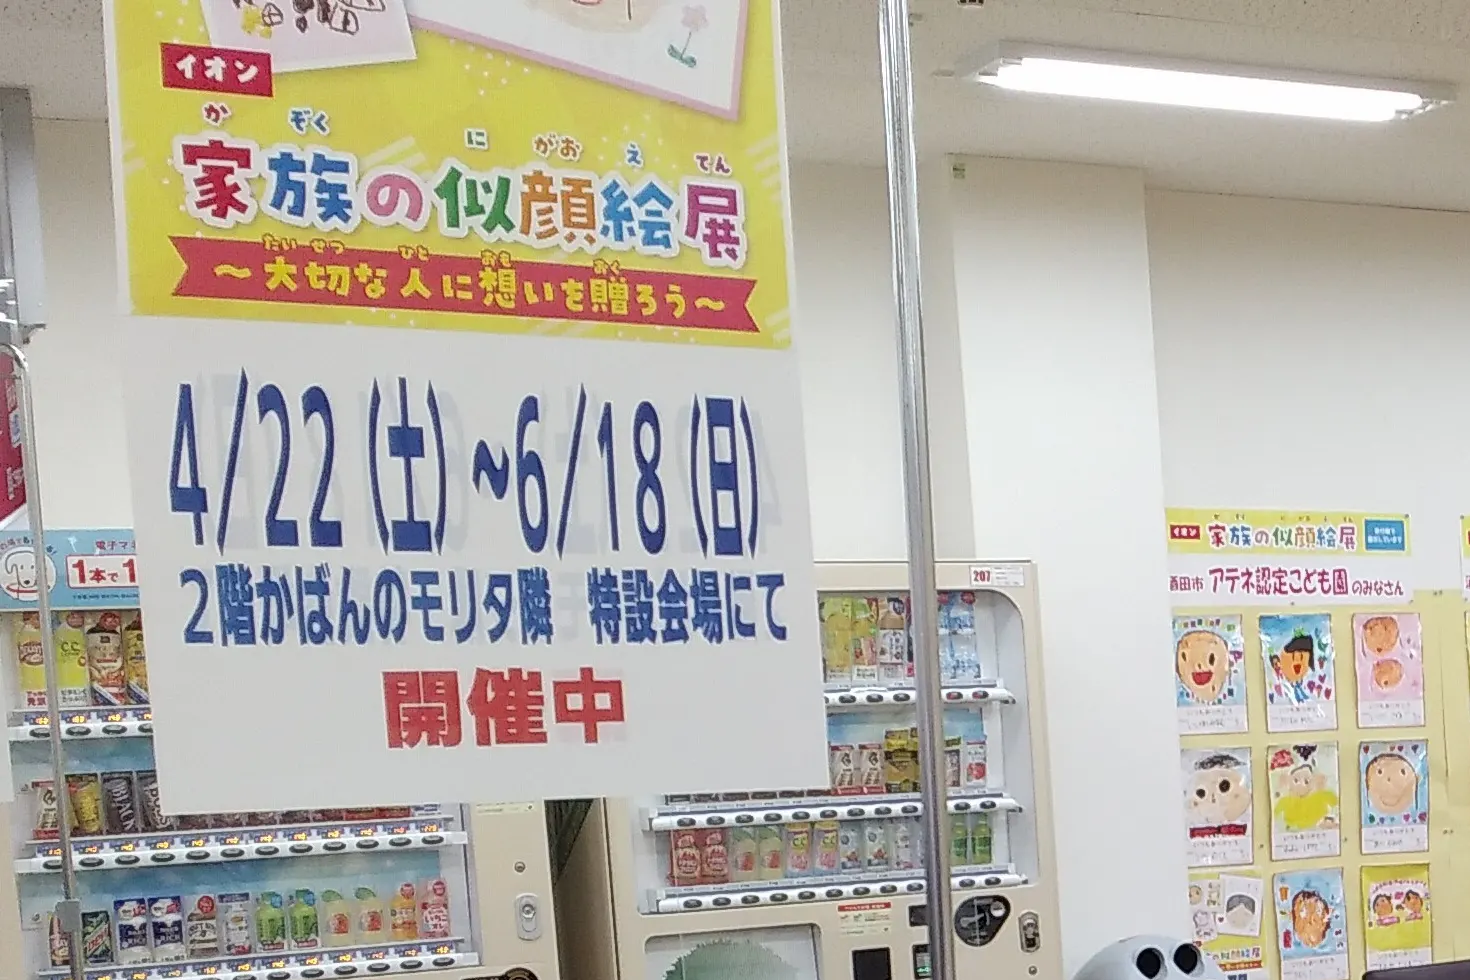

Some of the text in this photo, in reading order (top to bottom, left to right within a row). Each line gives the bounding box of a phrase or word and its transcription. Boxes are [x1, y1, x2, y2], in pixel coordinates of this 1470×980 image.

[174, 53, 260, 84] イオン
[181, 139, 740, 261] 家族の似顔絵展
[1208, 525, 1357, 549] 家族の似顔絵展
[588, 566, 787, 643] 特設会場にて
[1208, 568, 1348, 595] アテネ認定こども園
[1351, 579, 1404, 596] のみなさん
[382, 667, 625, 748] 開催中
